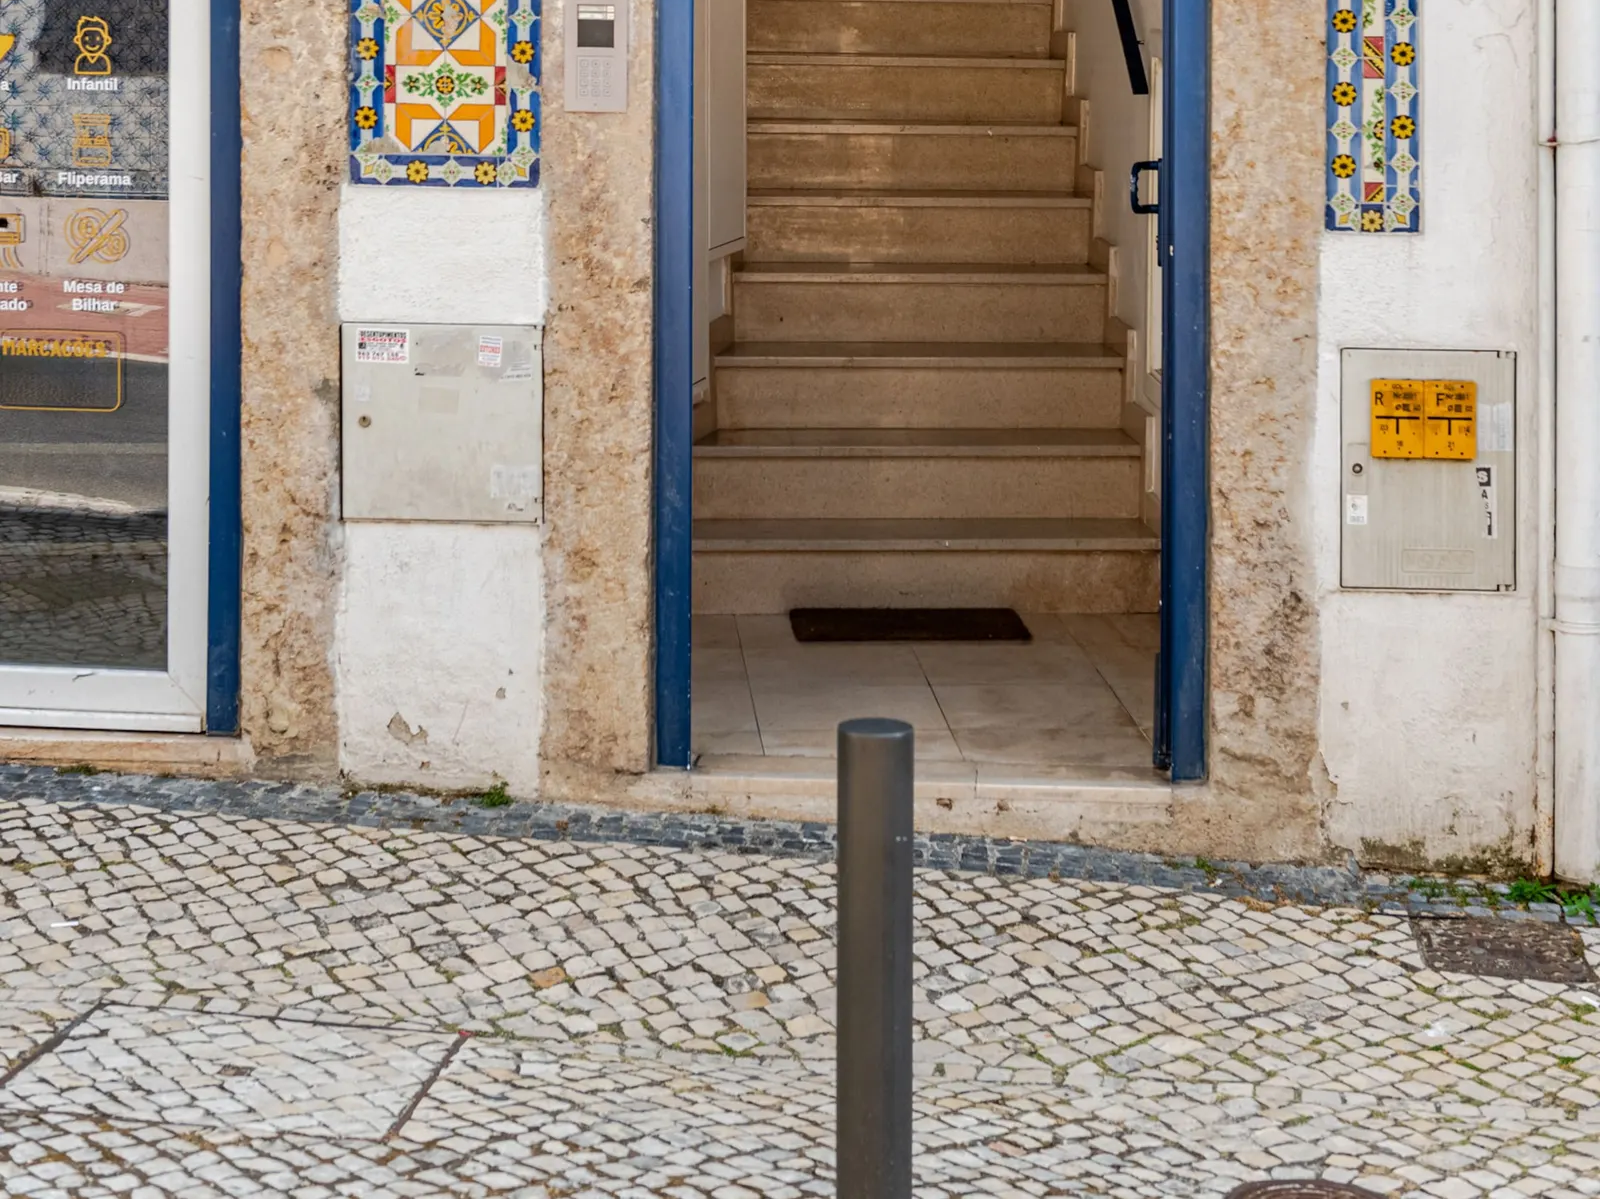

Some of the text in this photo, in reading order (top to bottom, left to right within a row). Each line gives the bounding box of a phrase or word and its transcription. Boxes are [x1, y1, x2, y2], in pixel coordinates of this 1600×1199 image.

[67, 78, 118, 91] Infantil
[58, 171, 131, 187] Fliperama
[63, 280, 125, 294] Mesa de
[72, 298, 117, 312] Bilhar
[1375, 391, 1384, 406] R
[1436, 393, 1445, 407] F
